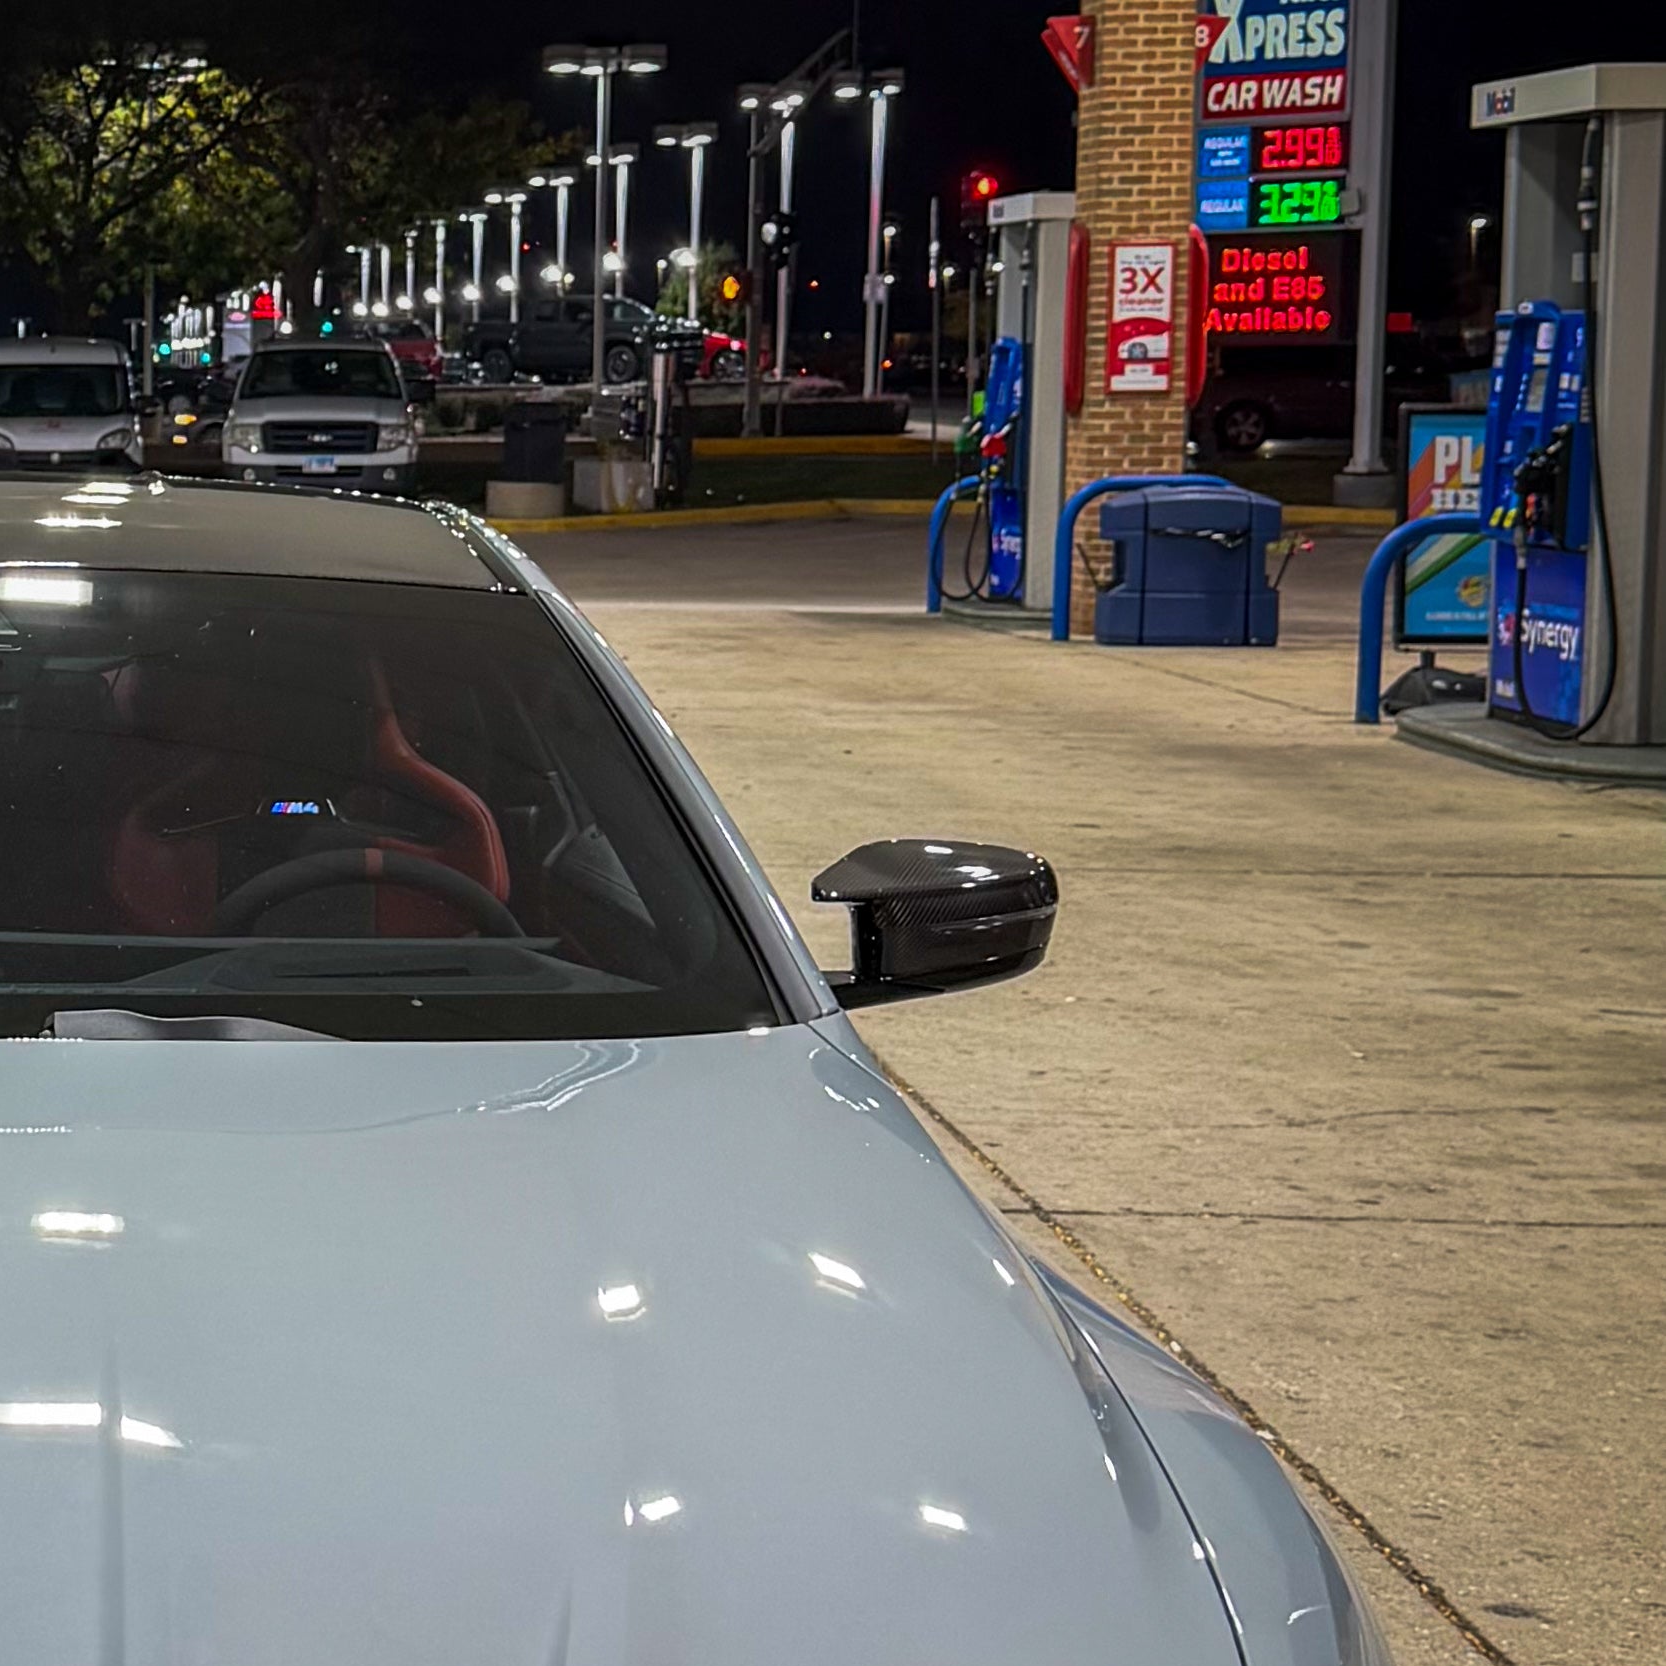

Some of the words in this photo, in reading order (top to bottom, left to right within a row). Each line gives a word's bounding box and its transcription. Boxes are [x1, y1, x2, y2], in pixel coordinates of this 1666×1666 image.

[1073, 25, 1091, 49] 7
[1195, 25, 1210, 48] 8
[1207, 80, 1258, 112] CAR
[1262, 75, 1344, 109] WASH
[1221, 246, 1309, 273] Diesel
[1119, 266, 1165, 295] 3X
[1213, 277, 1265, 302] and
[1272, 276, 1326, 301] E85
[1204, 306, 1332, 332] Available
[1434, 435, 1482, 485] PL
[1430, 488, 1482, 510] HE
